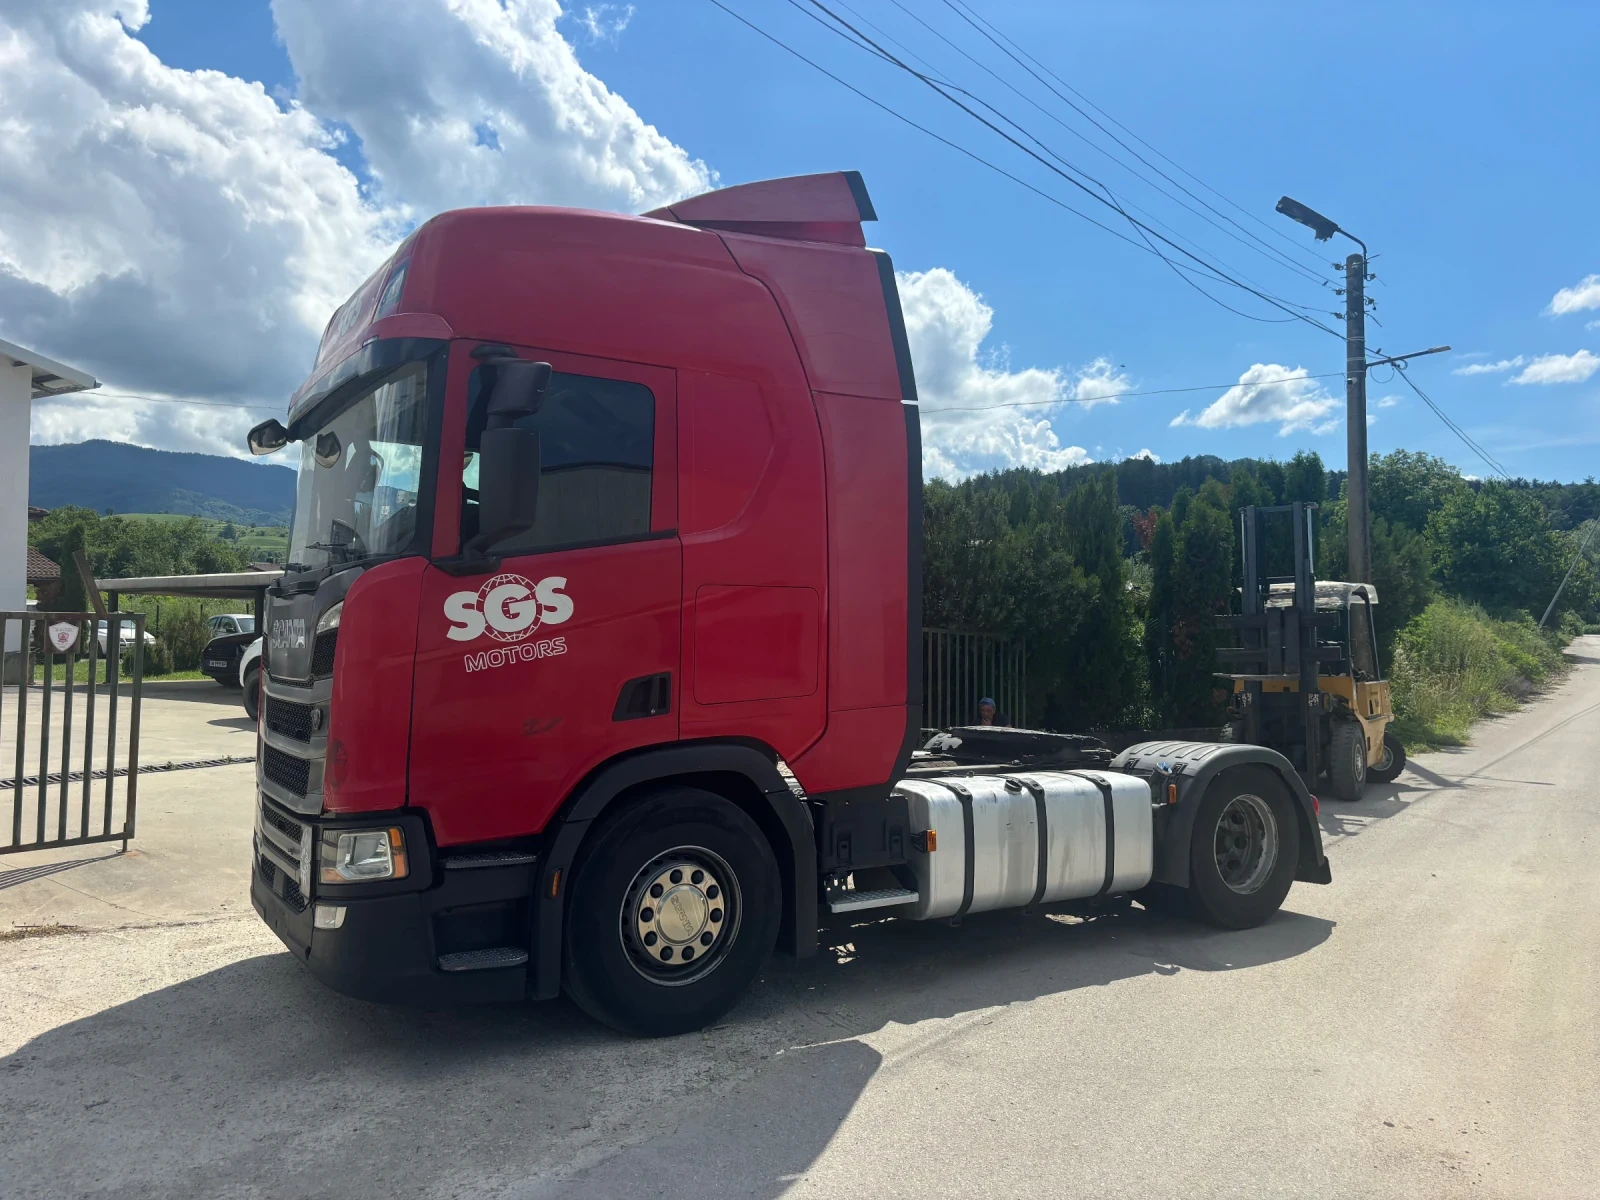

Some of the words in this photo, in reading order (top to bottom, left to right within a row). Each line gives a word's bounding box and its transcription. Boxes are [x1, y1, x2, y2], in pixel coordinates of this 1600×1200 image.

[444, 576, 574, 641] SGS
[464, 637, 567, 672] MOTORS
[671, 894, 694, 936] SCANIA
